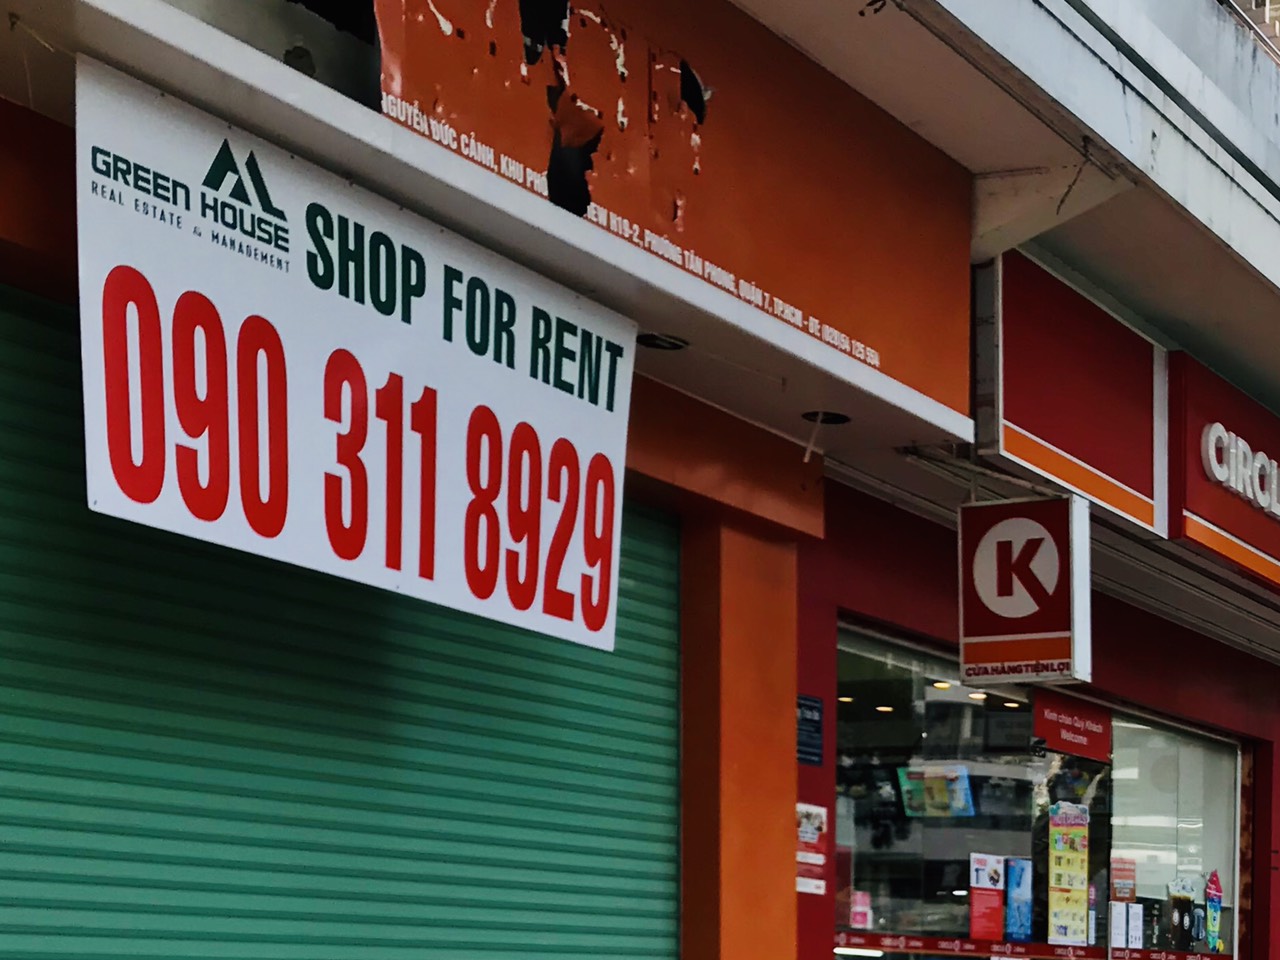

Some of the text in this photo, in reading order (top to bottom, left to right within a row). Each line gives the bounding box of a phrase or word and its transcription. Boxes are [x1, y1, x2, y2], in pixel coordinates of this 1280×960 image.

[500, 153, 524, 182] KHU
[91, 180, 124, 206] REAL
[134, 198, 182, 229] ESTATE
[211, 230, 290, 273] MANAGEMENT
[200, 191, 290, 253] HOUSE
[305, 201, 624, 413] SHOP FOR RENT
[102, 264, 615, 632] 090 311 8929
